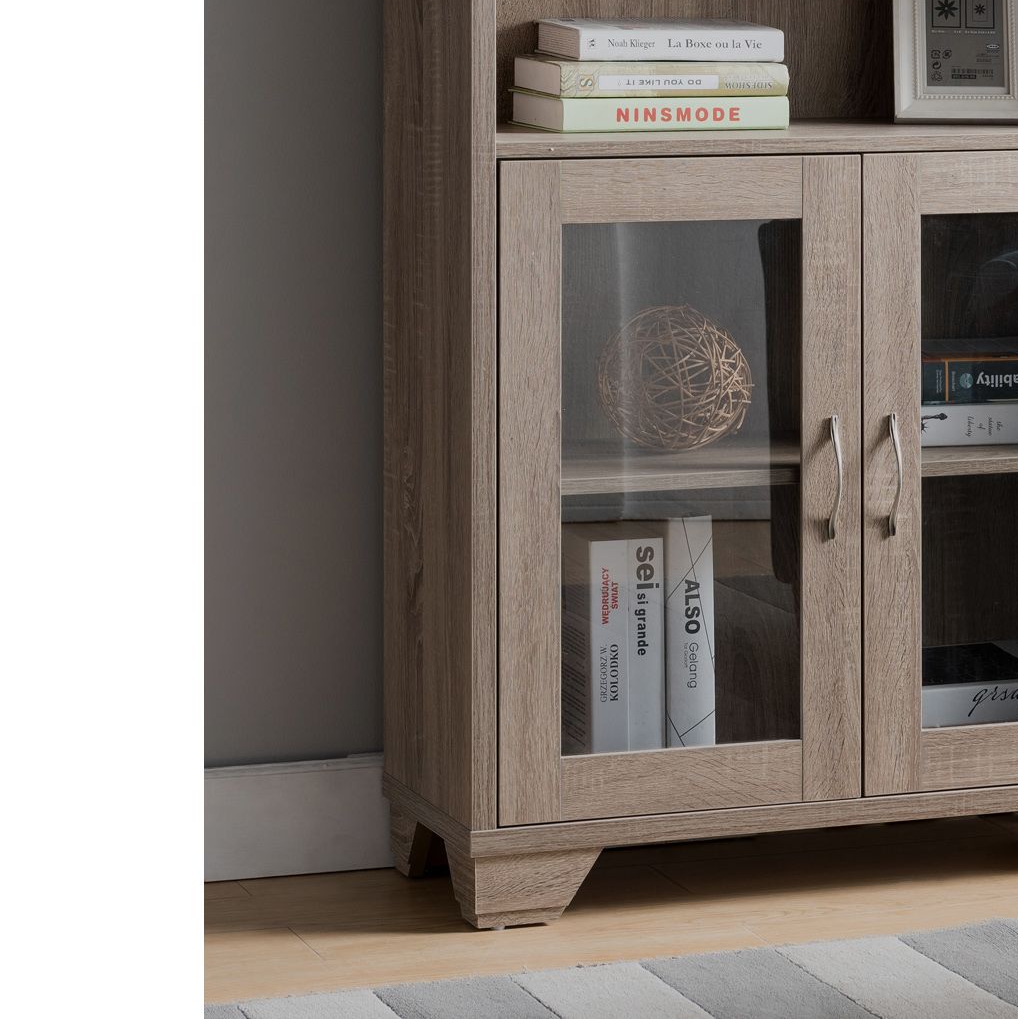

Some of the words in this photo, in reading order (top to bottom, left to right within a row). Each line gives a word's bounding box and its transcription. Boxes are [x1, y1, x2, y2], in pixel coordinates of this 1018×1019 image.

[607, 38, 629, 49] Noah
[630, 38, 656, 49] Klieger
[667, 38, 682, 49] La
[685, 39, 712, 49] Boxe
[715, 41, 729, 49] ou
[732, 38, 742, 49] la
[745, 39, 763, 49] Vie
[616, 107, 741, 122] NINSMODE
[636, 592, 649, 605] si
[684, 578, 701, 635] ALSO
[634, 608, 649, 656] grande
[600, 656, 608, 703] GRZEGORZ
[687, 641, 700, 689] Gelang
